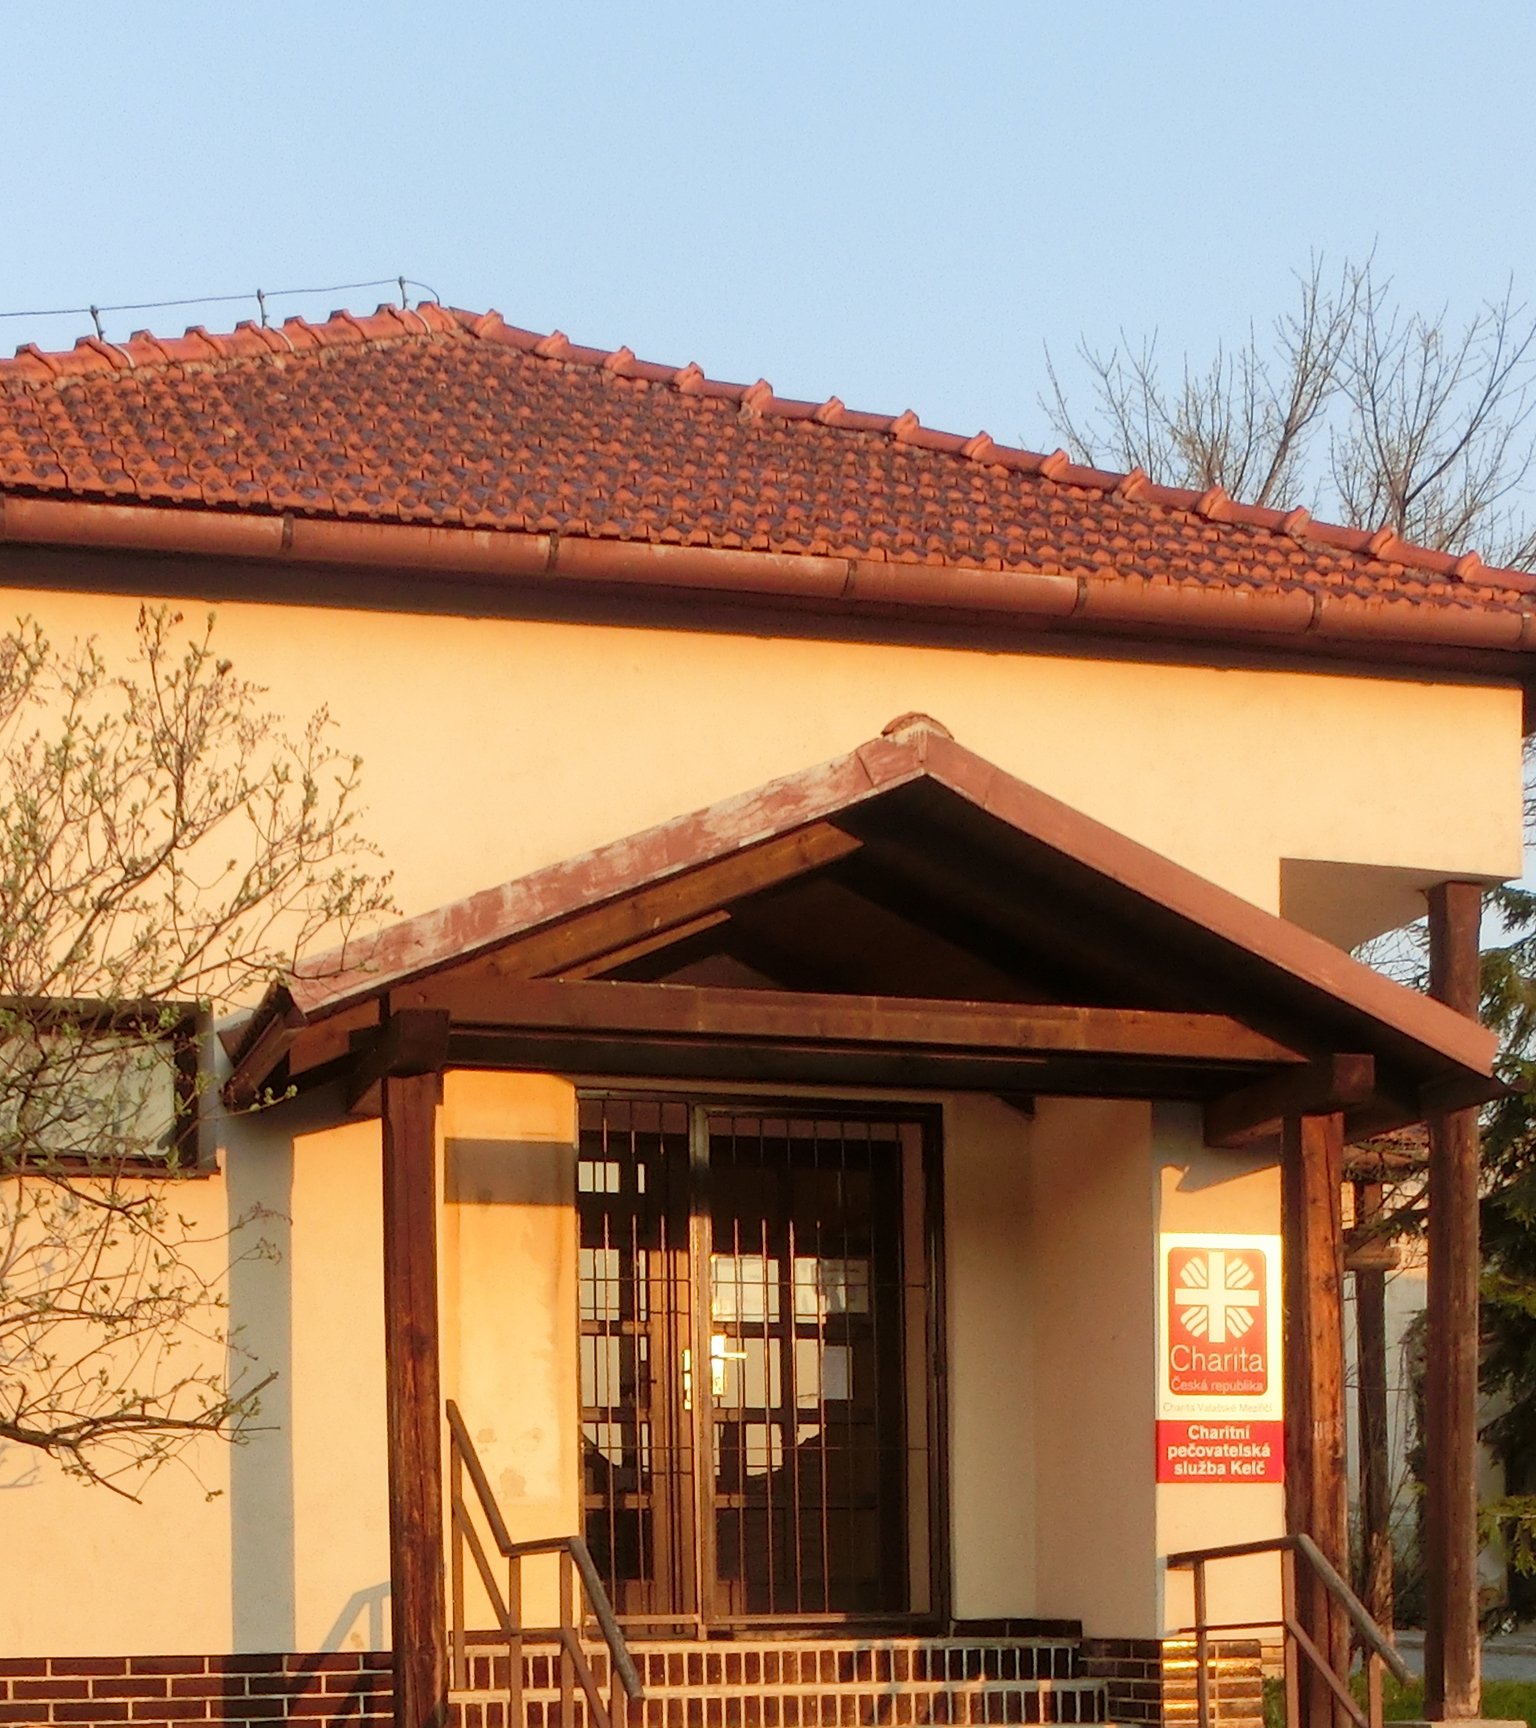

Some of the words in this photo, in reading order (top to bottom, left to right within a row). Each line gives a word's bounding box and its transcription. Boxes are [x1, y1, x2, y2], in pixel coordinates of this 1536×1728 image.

[1170, 1344, 1264, 1373] Charita
[1170, 1375, 1209, 1391] Česká
[1211, 1379, 1264, 1394] republika
[1187, 1424, 1250, 1440] Charitní
[1167, 1442, 1271, 1460] pečovatelská
[1174, 1460, 1226, 1475] služba
[1230, 1460, 1265, 1475] Kelč
